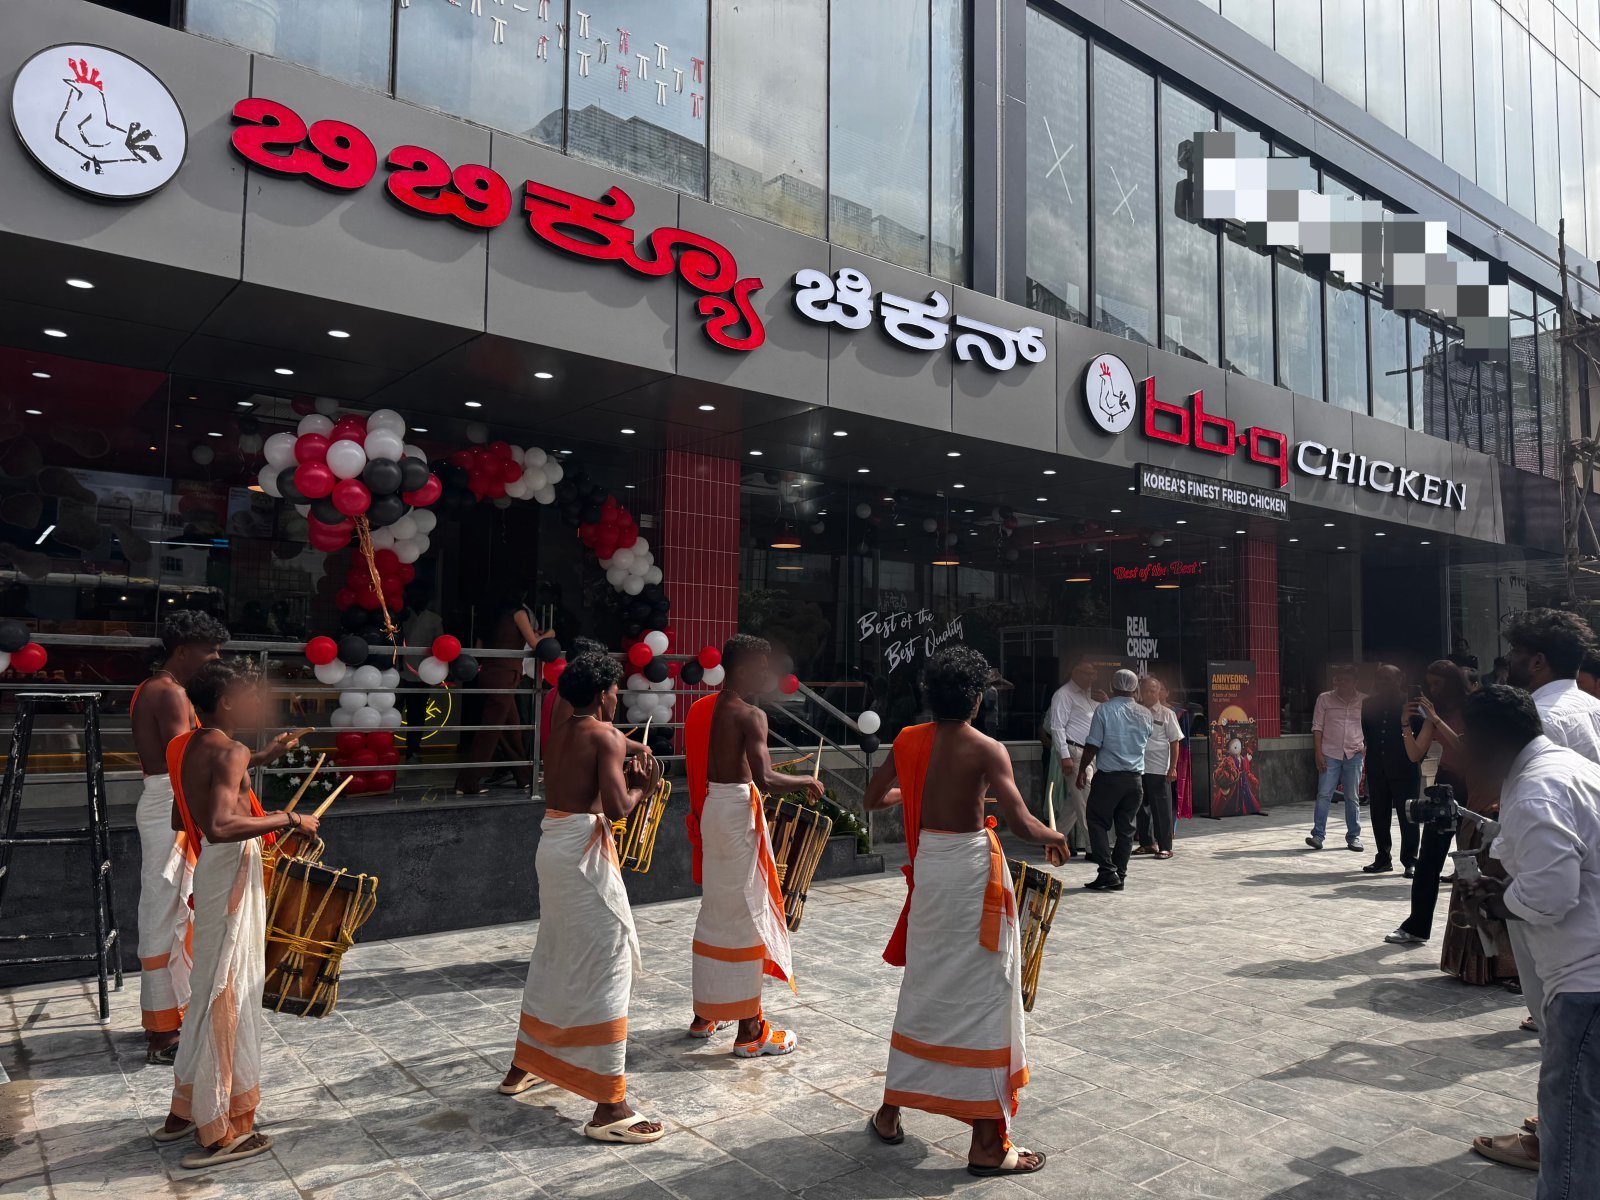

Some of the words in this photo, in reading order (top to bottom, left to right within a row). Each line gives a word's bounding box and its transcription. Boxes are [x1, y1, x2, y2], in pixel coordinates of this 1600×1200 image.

[793, 267, 1047, 371] ಚಿಕನ್
[1143, 472, 1186, 494] KOREA'S
[1188, 480, 1220, 500] FINEST
[1222, 488, 1248, 505] FRIED
[1249, 493, 1287, 513] CHICKEN
[1296, 439, 1467, 511] CHICKEN
[857, 611, 906, 642] Best
[900, 614, 913, 630] of
[914, 607, 935, 625] the
[1126, 615, 1150, 637] REAL
[884, 635, 922, 674] Best
[925, 614, 963, 658] Quality
[1126, 638, 1159, 659] CRISPY.
[1211, 673, 1250, 685] ANNYEONG,
